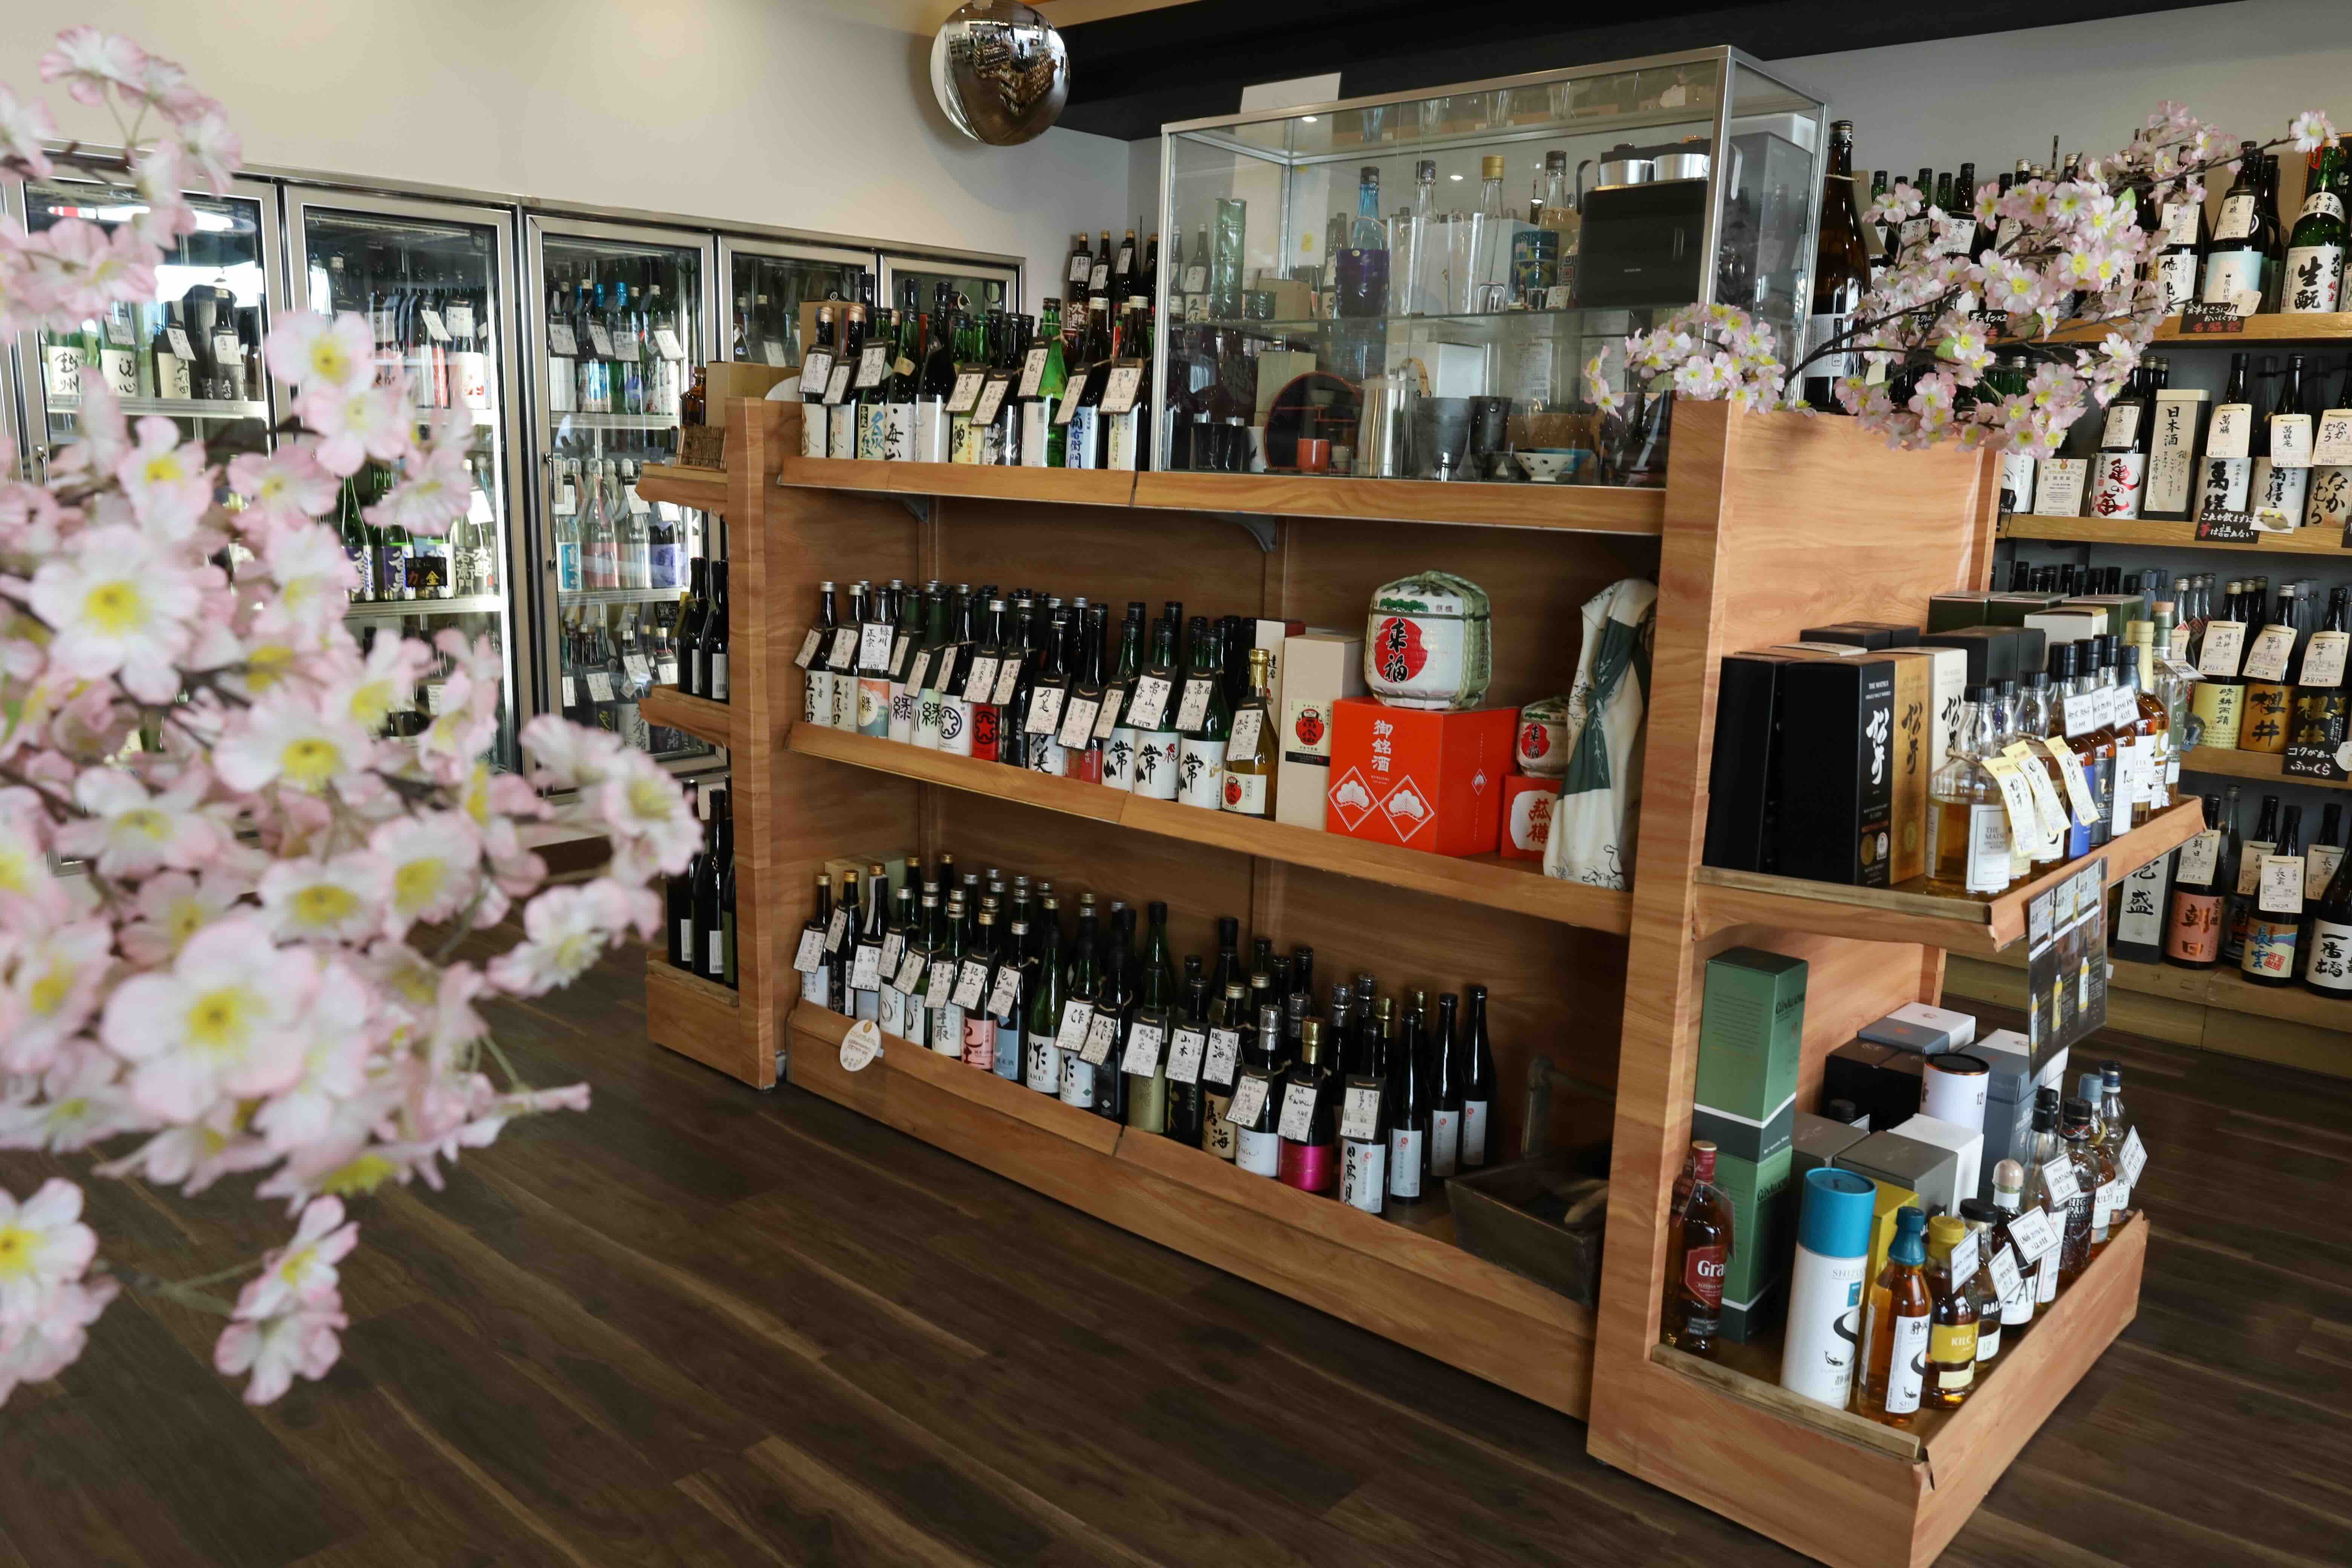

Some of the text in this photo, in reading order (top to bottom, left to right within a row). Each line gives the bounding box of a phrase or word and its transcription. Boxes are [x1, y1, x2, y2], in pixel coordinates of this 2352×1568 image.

[2294, 256, 2323, 310] 生酛
[2165, 406, 2180, 446] 日本酒
[2334, 421, 2347, 439] なか
[2311, 482, 2328, 524] むら
[2326, 471, 2349, 513] なか
[2199, 523, 2254, 537] 芋は語れない
[867, 628, 876, 648] 正宗
[1383, 617, 1408, 683] 来福
[2216, 688, 2234, 725] 晴耕雨読
[1371, 719, 1393, 773] 御銘酒
[2290, 760, 2331, 775] ふっくら
[1977, 1092, 1984, 1106] 12
[1697, 1260, 1725, 1277] Gra
[1951, 1335, 1972, 1347] KILC
